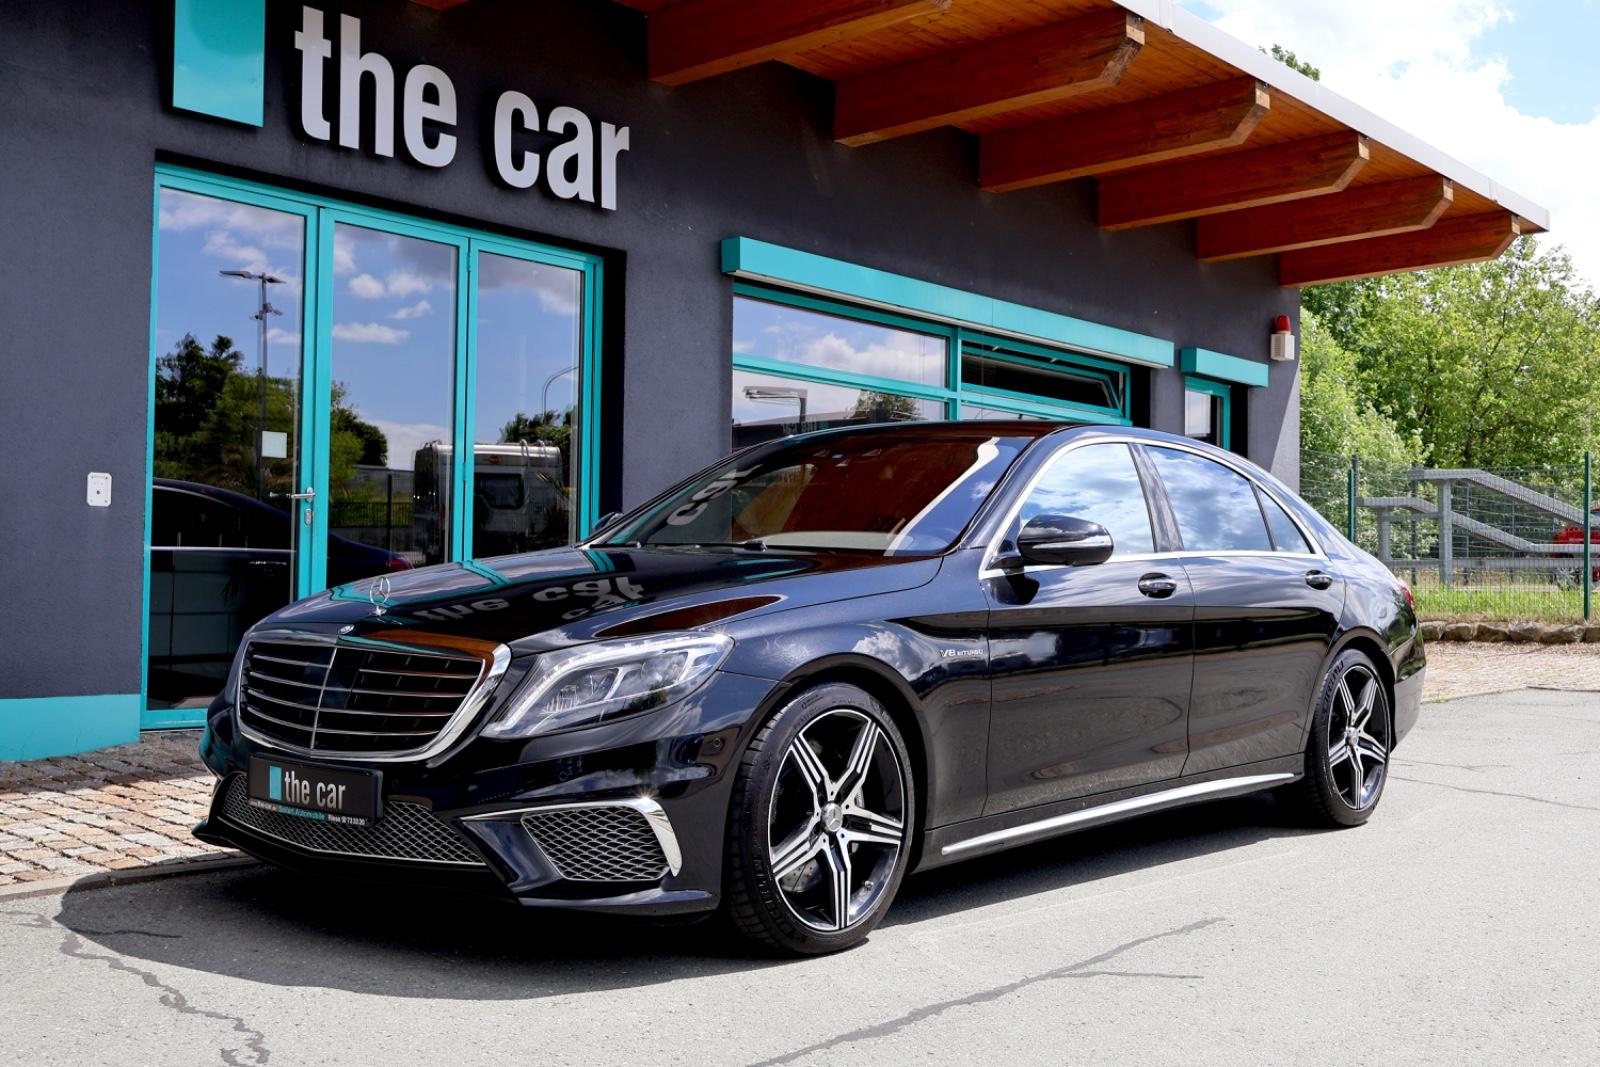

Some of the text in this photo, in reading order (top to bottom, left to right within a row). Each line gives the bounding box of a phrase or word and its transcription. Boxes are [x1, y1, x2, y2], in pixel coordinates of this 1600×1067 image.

[294, 6, 631, 211] the car
[284, 770, 310, 805] the
[316, 781, 346, 810] car
